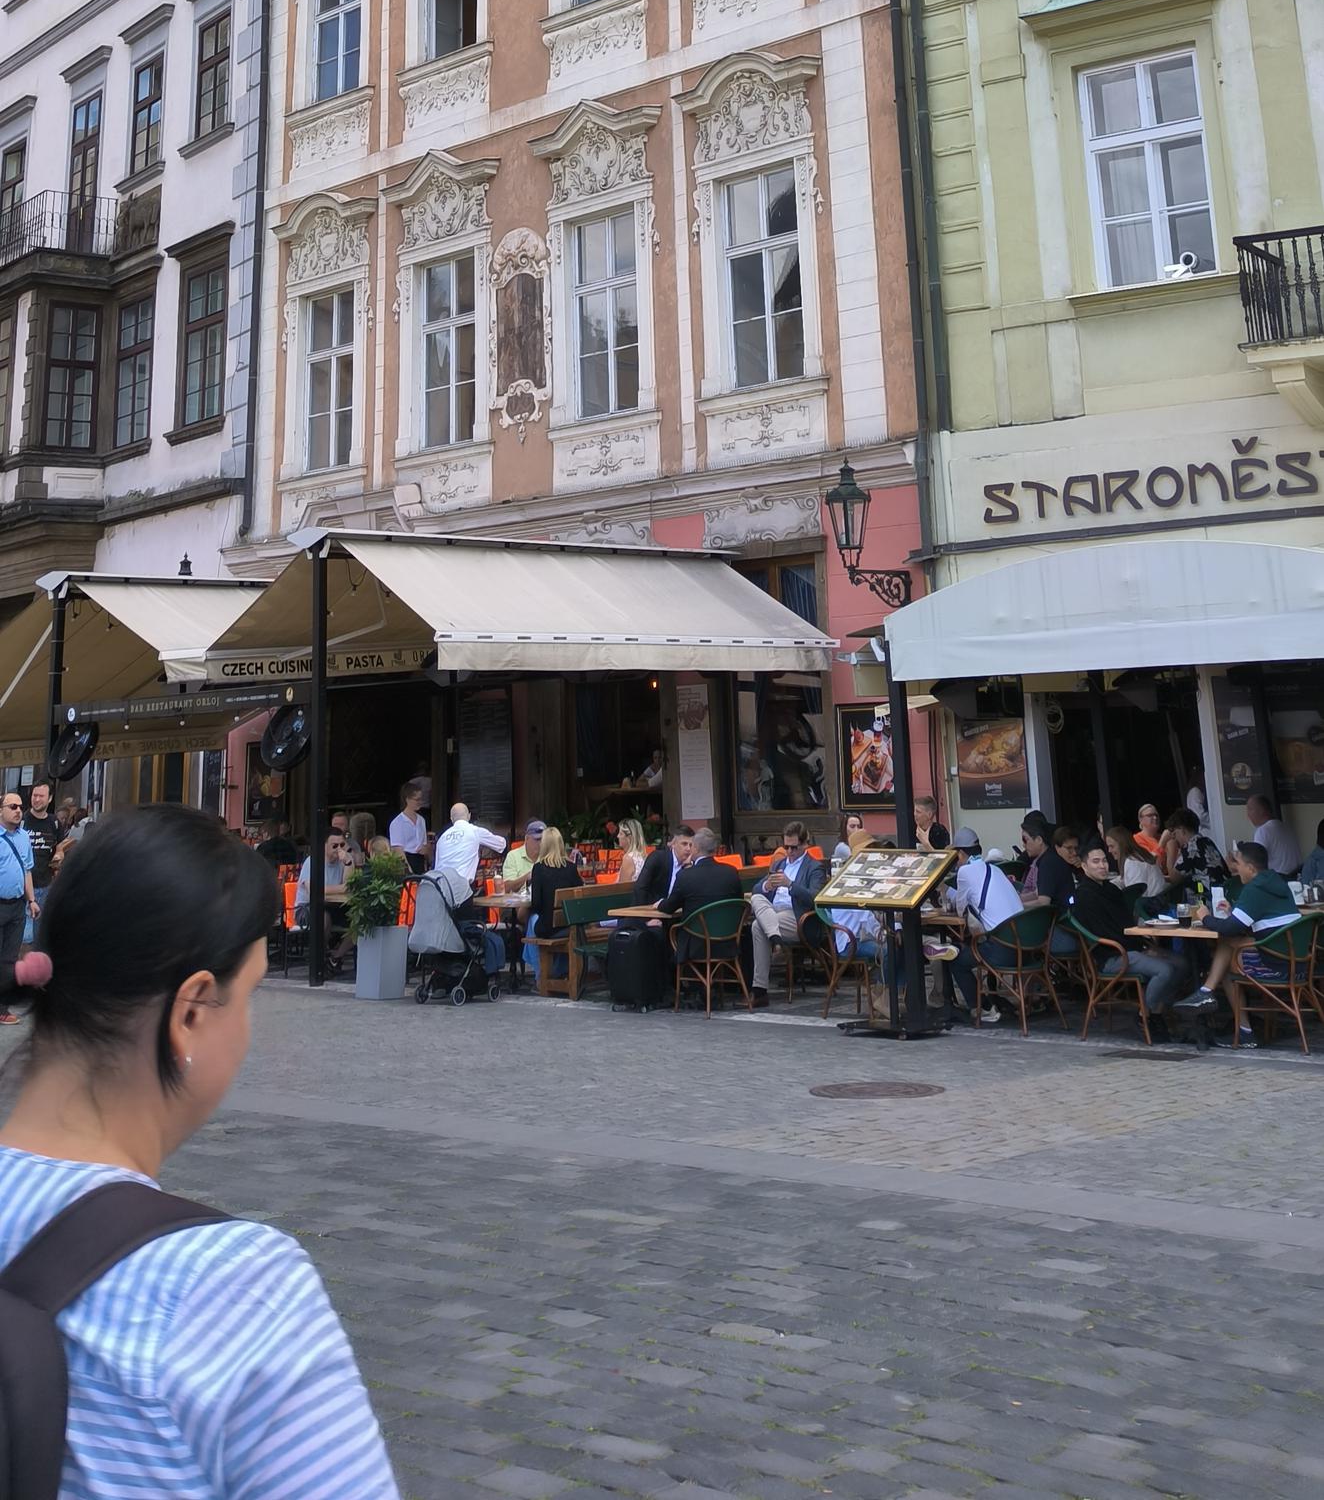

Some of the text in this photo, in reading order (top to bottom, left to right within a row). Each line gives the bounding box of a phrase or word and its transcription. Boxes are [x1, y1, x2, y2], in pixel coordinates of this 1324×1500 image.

[983, 436, 1324, 523] STAROMĚS
[222, 662, 264, 677] CZECH
[346, 655, 384, 669] PASTA
[130, 704, 144, 713] BAR
[147, 699, 192, 712] RESTAURANT
[196, 697, 219, 707] ORLOJ
